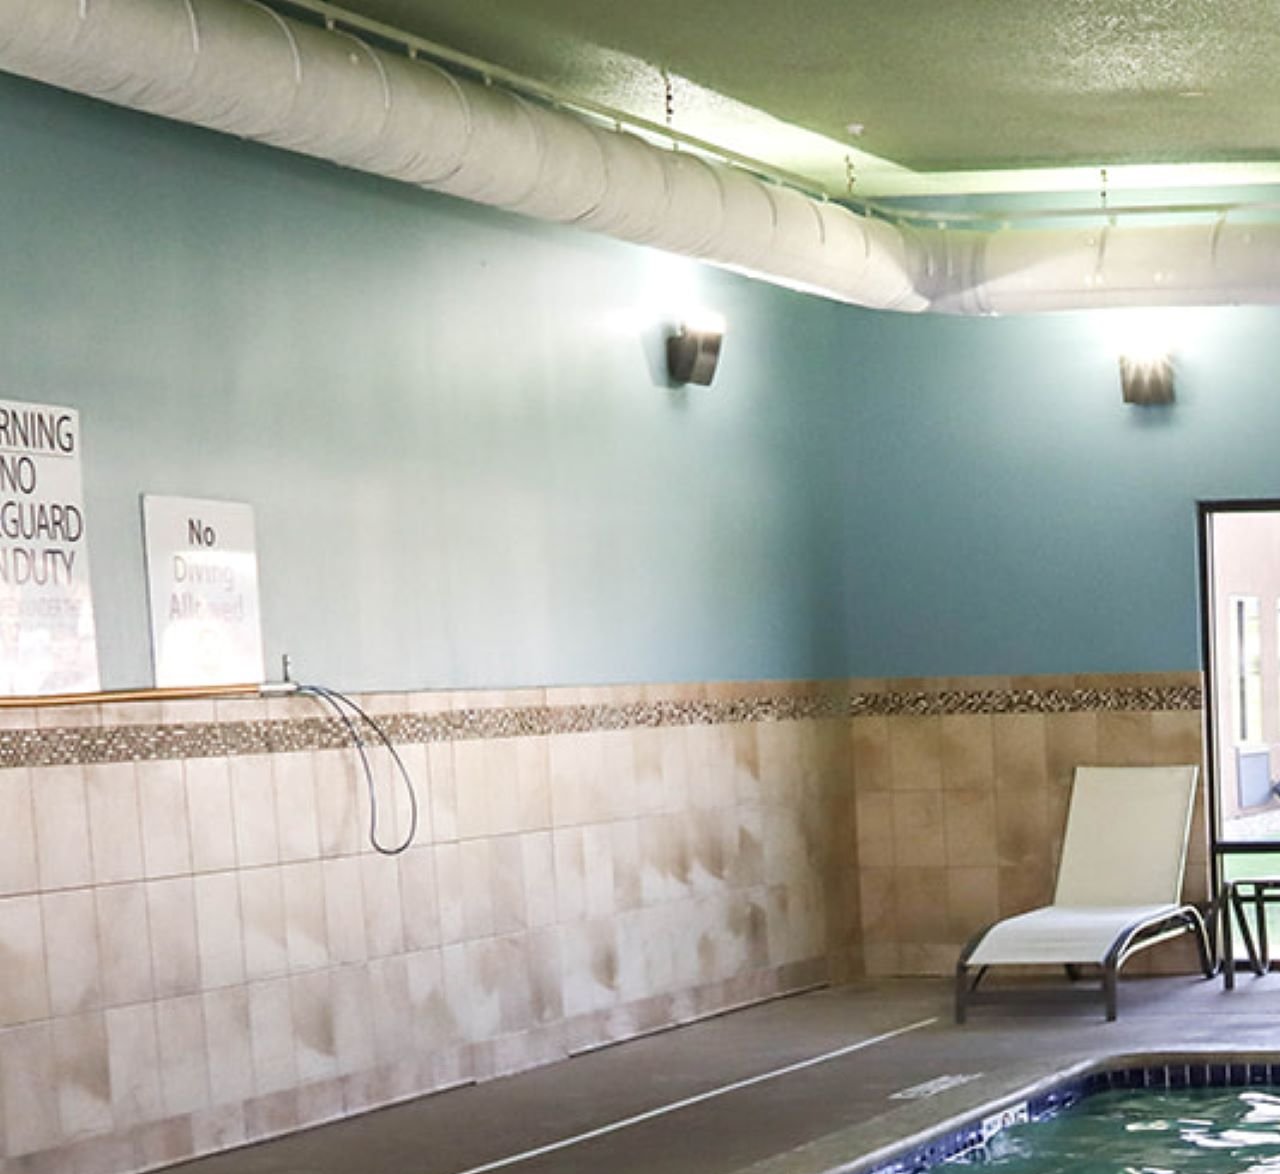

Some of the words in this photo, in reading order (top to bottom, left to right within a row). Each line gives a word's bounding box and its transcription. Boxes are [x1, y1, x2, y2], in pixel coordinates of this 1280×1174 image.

[0, 456, 36, 494] NO
[0, 501, 82, 542] GUARD
[188, 517, 216, 547] No
[13, 548, 75, 586] DUTY
